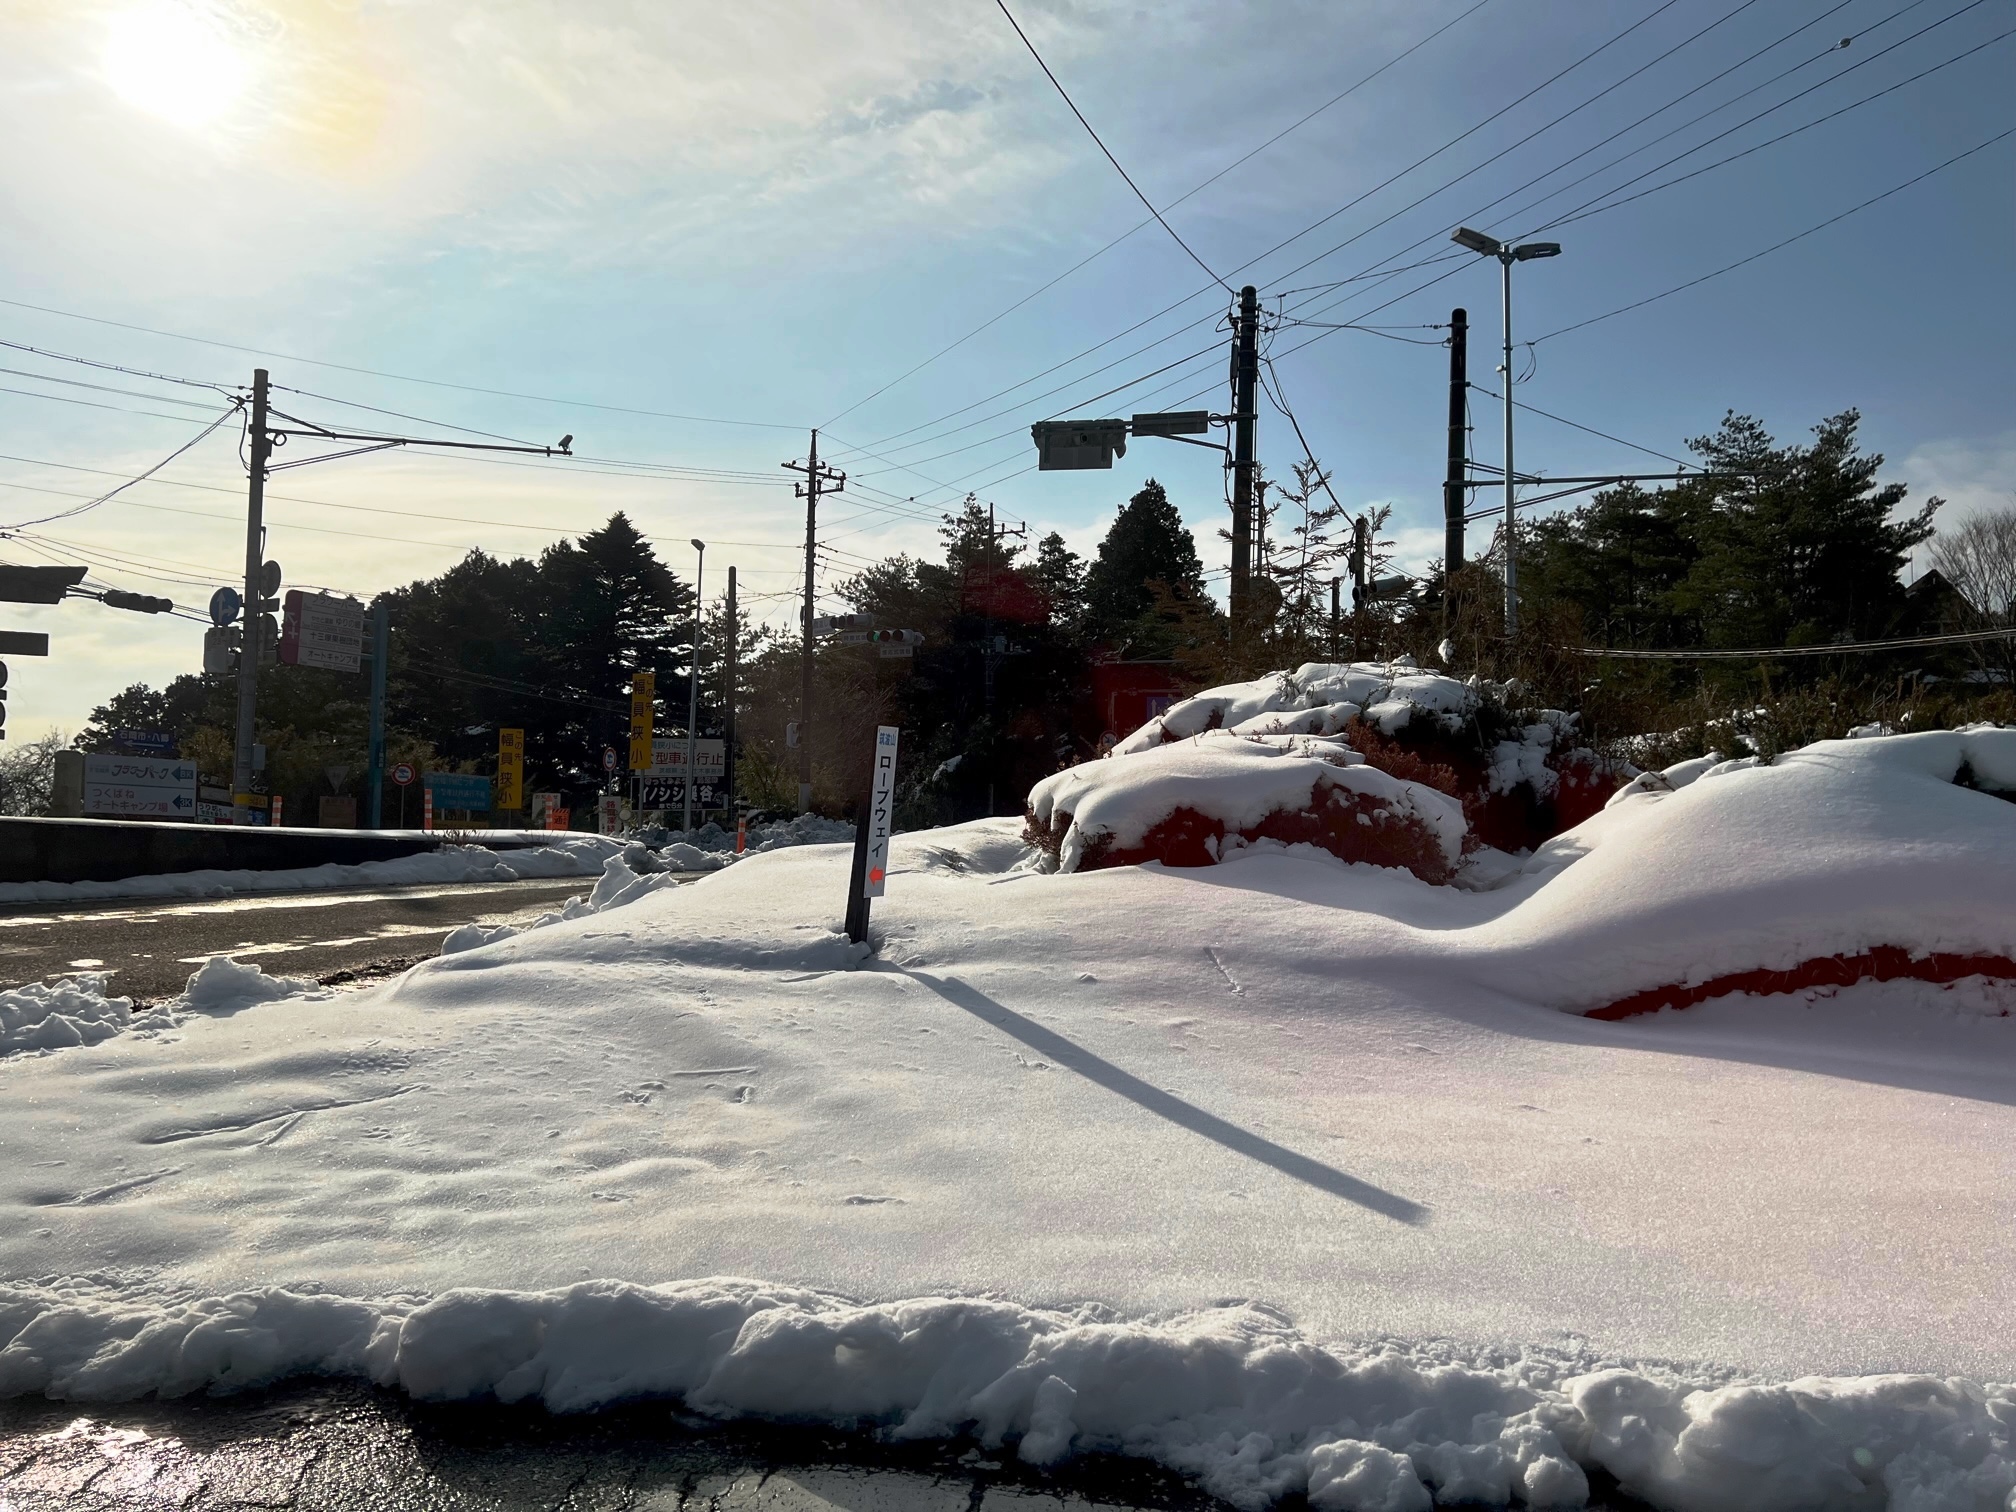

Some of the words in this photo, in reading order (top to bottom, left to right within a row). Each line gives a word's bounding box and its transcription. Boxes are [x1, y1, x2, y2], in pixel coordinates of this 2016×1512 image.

[307, 650, 358, 665] オートキャンプ場
[644, 675, 654, 712] この先
[630, 680, 645, 764] 幅員狭小
[514, 731, 523, 762] この先
[879, 732, 897, 747] 筑波山
[111, 764, 169, 780] フラワーパーク
[499, 733, 514, 804] 幅員狭小
[92, 788, 135, 799] つくばね
[92, 800, 168, 812] オートキャンプ場
[180, 798, 192, 807] 3K
[872, 756, 891, 858] ロープウェイ
